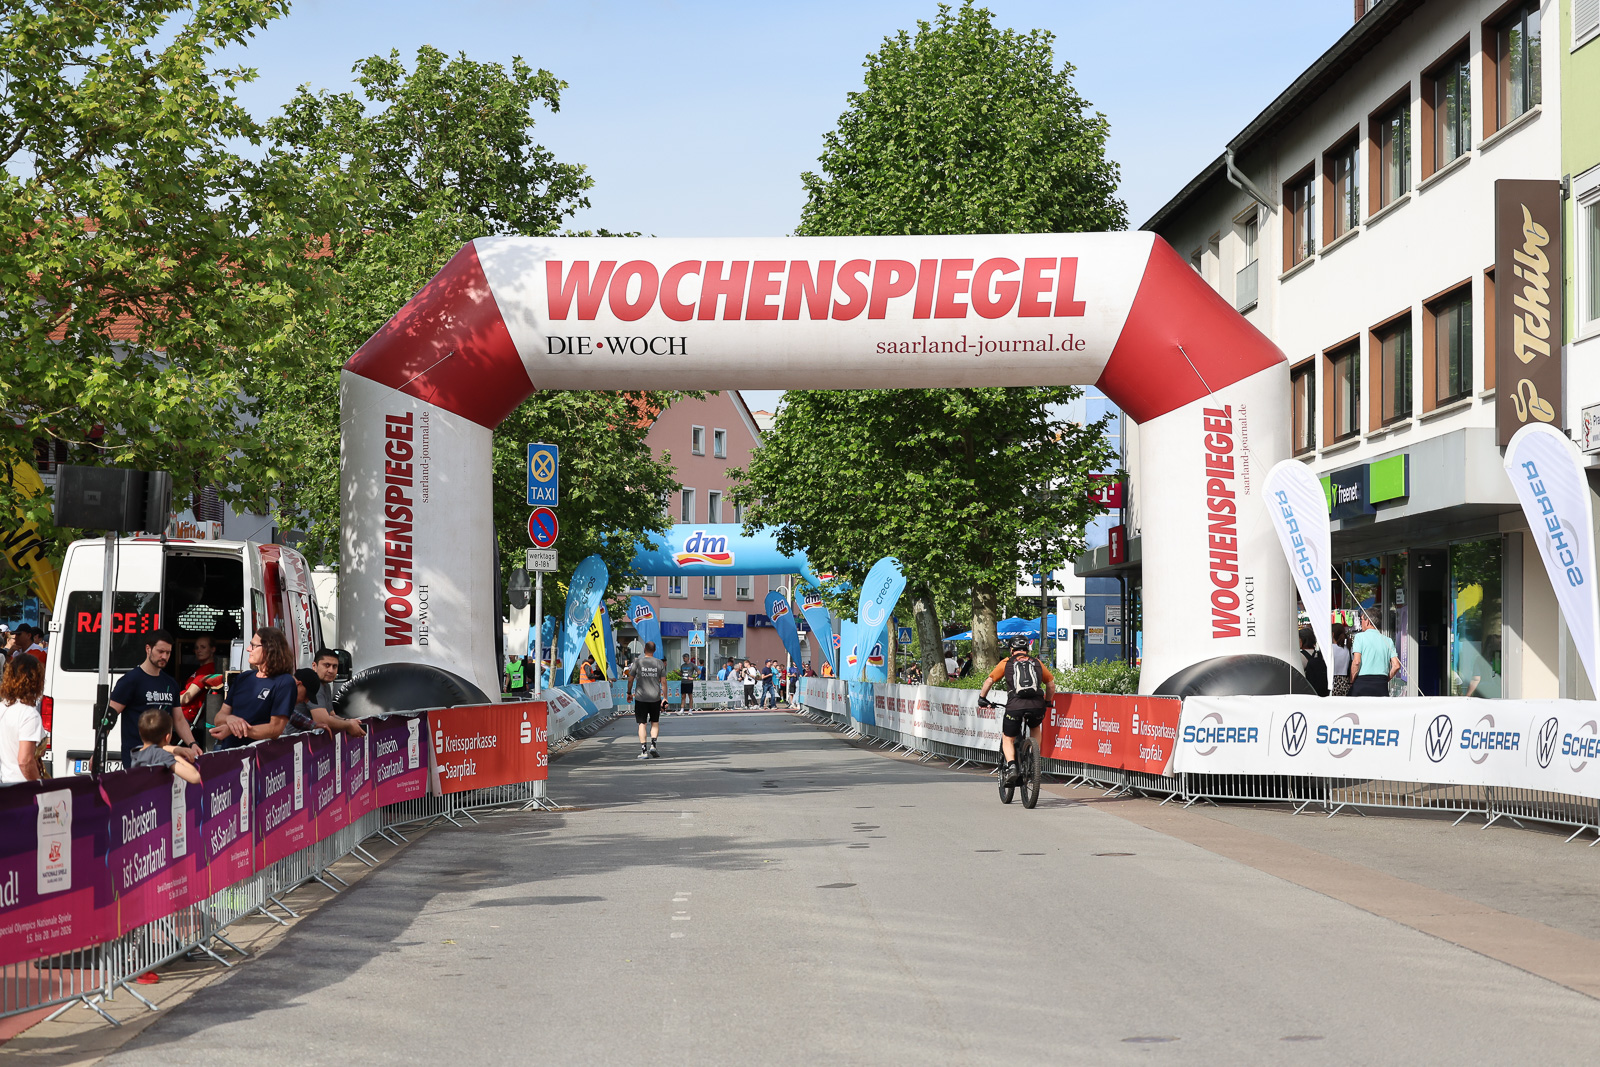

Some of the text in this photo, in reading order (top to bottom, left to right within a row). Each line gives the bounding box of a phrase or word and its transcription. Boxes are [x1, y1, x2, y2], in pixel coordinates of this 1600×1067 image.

[545, 257, 1087, 322] WOCHENSPIEGEL
[1513, 203, 1550, 364] Tchibo
[876, 334, 1086, 357] saarland-journal.de
[420, 411, 431, 503] saarland-journal.de
[1238, 404, 1250, 495] saarland-journal.de
[530, 486, 555, 501] TAXI
[1338, 482, 1358, 503] freenet
[384, 412, 414, 647] WOCHENSPIEGEL
[1203, 404, 1241, 639] WOCHENSPIEGEL
[686, 532, 726, 553] dm
[528, 552, 555, 561] werktags
[582, 576, 596, 605] creos
[805, 592, 820, 604] dm
[875, 576, 893, 605] creos
[635, 605, 649, 618] dm
[772, 600, 786, 615] dm
[1056, 715, 1084, 731] Kreissparkasse
[445, 731, 497, 755] Kreissparkasse
[1183, 725, 1258, 744] SCHERER
[1316, 724, 1400, 747] SCHERER
[1460, 728, 1520, 751] SCHERER
[445, 758, 477, 781] Saarpfalz
[121, 802, 158, 845] Dabeisein
[123, 859, 133, 889] ist
[133, 838, 167, 883] Saarland!
[14, 921, 36, 934] Olympics
[36, 914, 58, 928] Nationale
